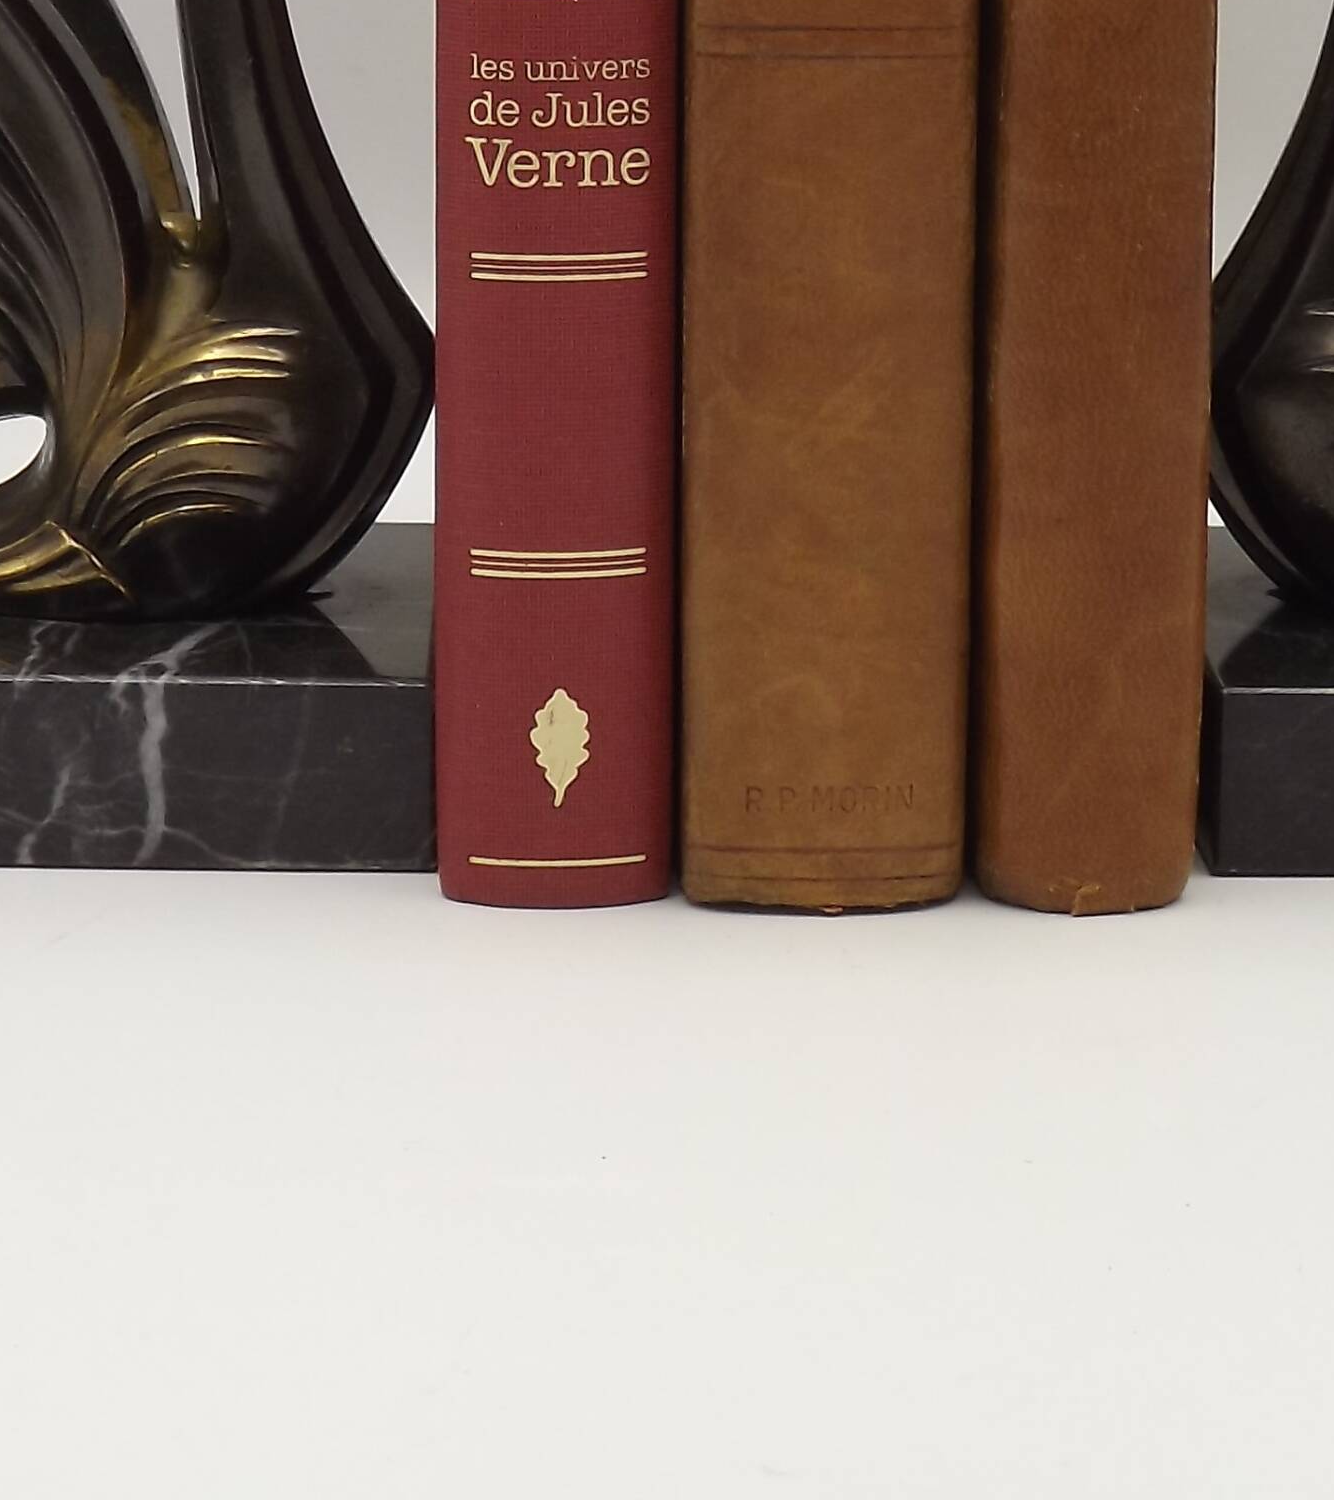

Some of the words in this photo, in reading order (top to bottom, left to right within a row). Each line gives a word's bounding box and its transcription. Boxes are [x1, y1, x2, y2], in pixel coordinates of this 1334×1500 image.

[469, 52, 515, 81] les
[524, 55, 651, 81] univers
[469, 90, 521, 127] de
[530, 91, 651, 128] Jules
[464, 136, 651, 189] Verne
[811, 781, 915, 814] MORIN
